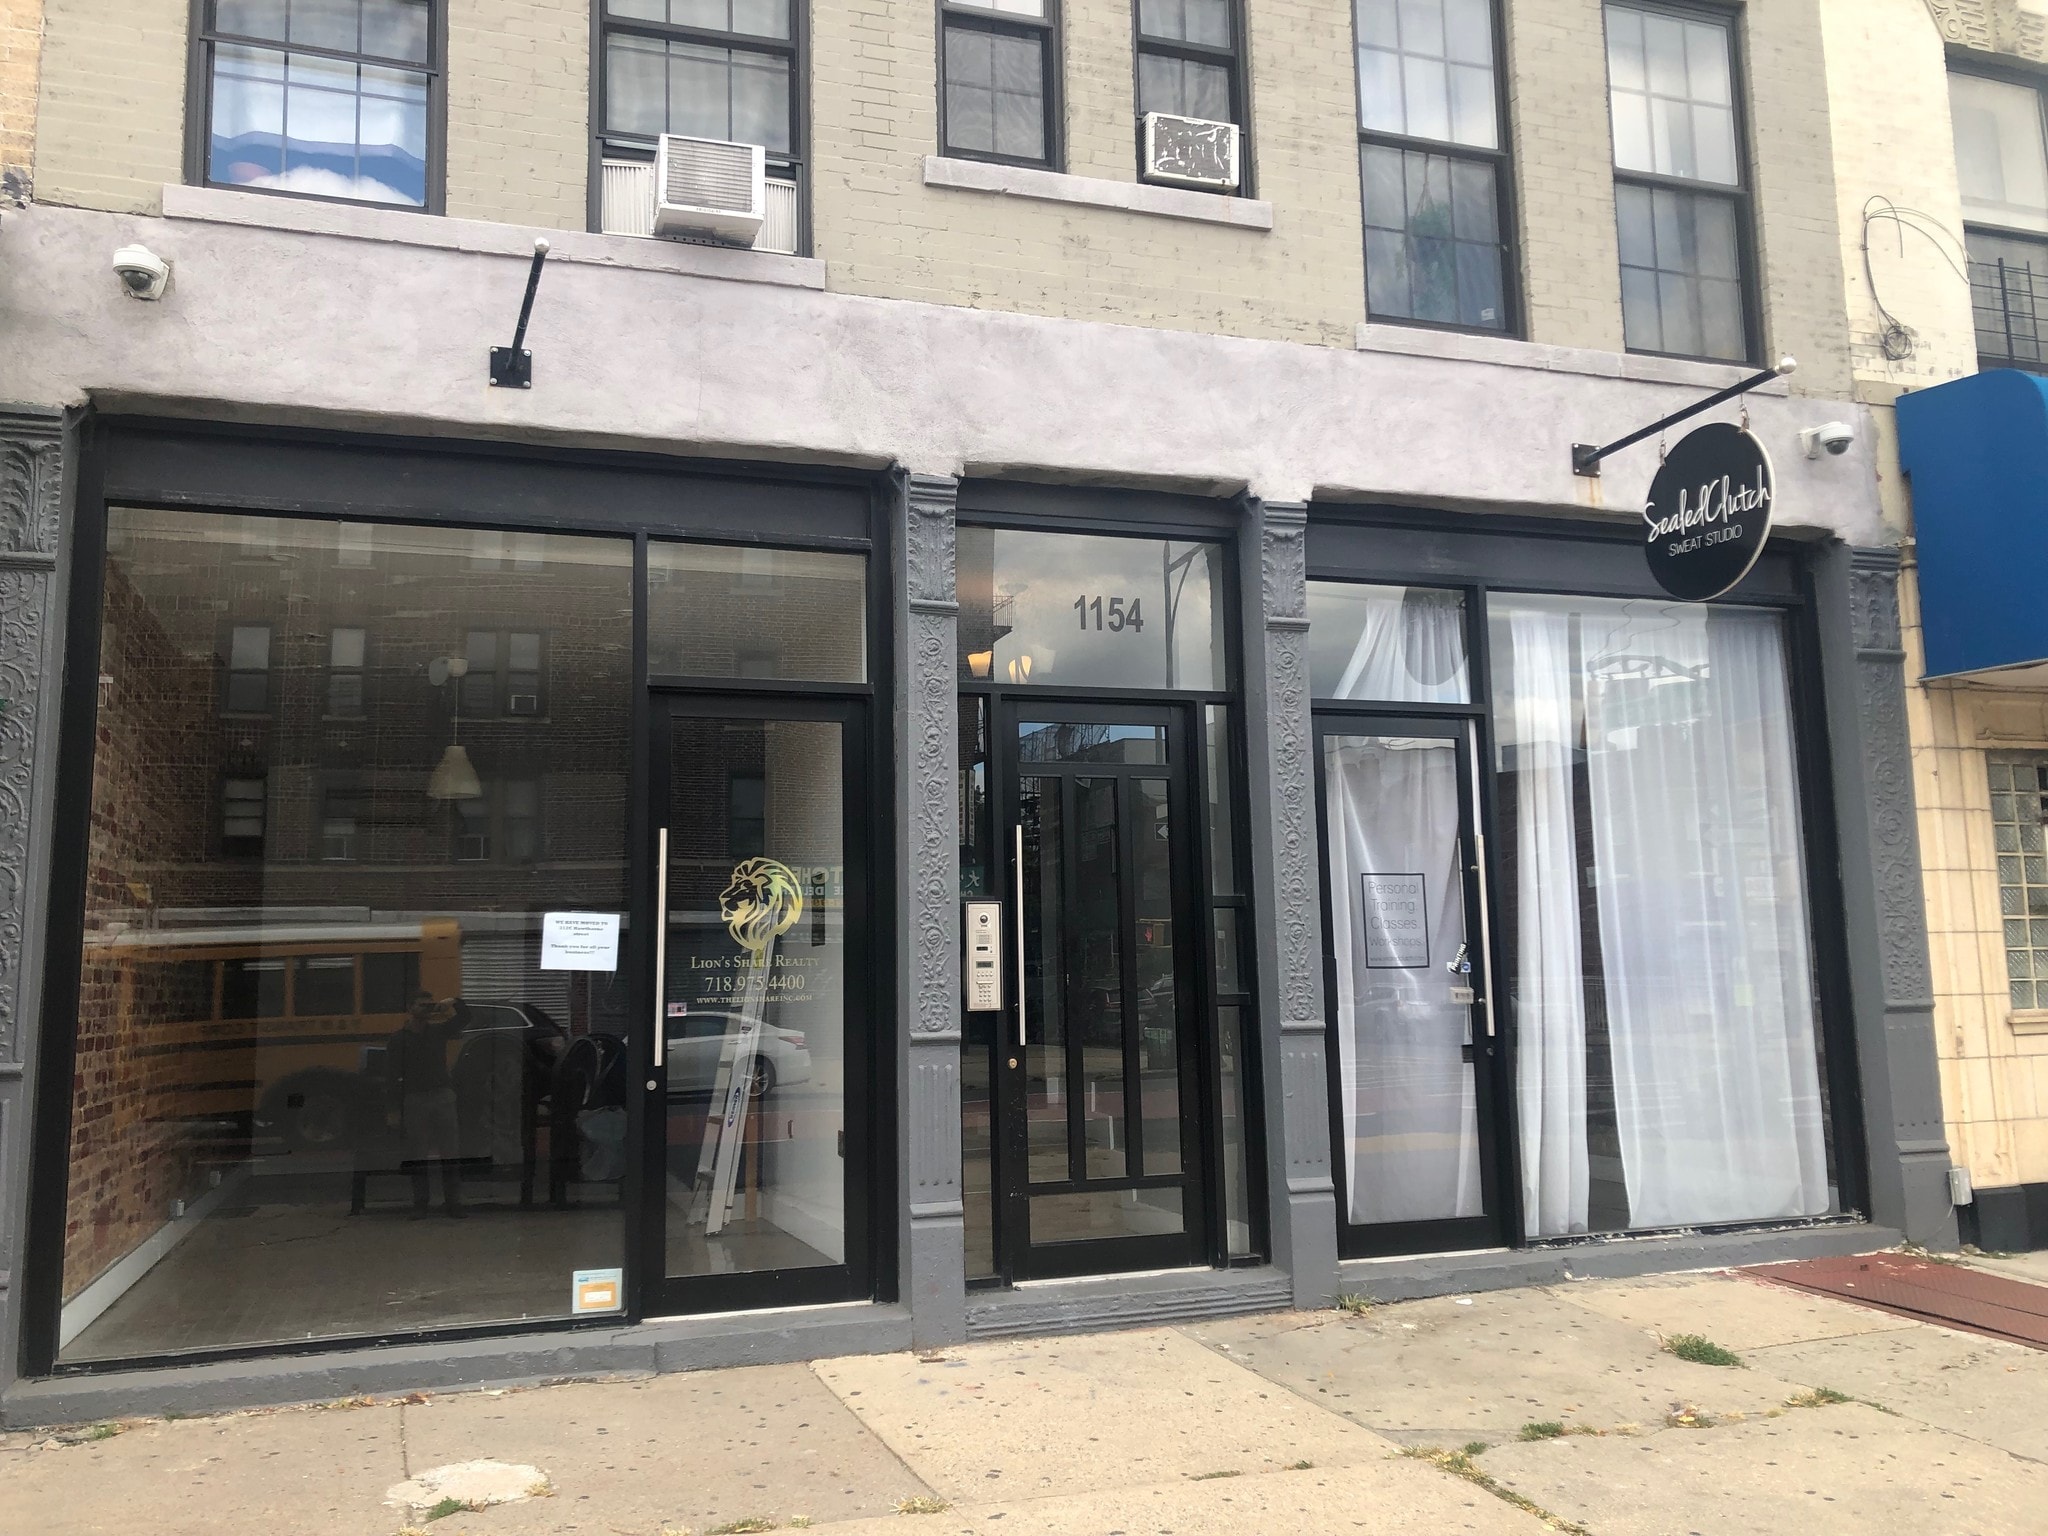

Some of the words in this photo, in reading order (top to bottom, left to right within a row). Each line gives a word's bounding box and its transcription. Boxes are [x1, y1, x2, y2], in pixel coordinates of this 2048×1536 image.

[1643, 464, 1772, 543] SealedClutch
[1668, 535, 1703, 557] SWEAT
[1704, 524, 1743, 547] STUDIO
[1073, 594, 1144, 633] 1154
[1368, 881, 1419, 895] Personal
[733, 955, 772, 968] SHARE
[775, 954, 820, 967] REALTY
[704, 974, 806, 992] 718.975.4400
